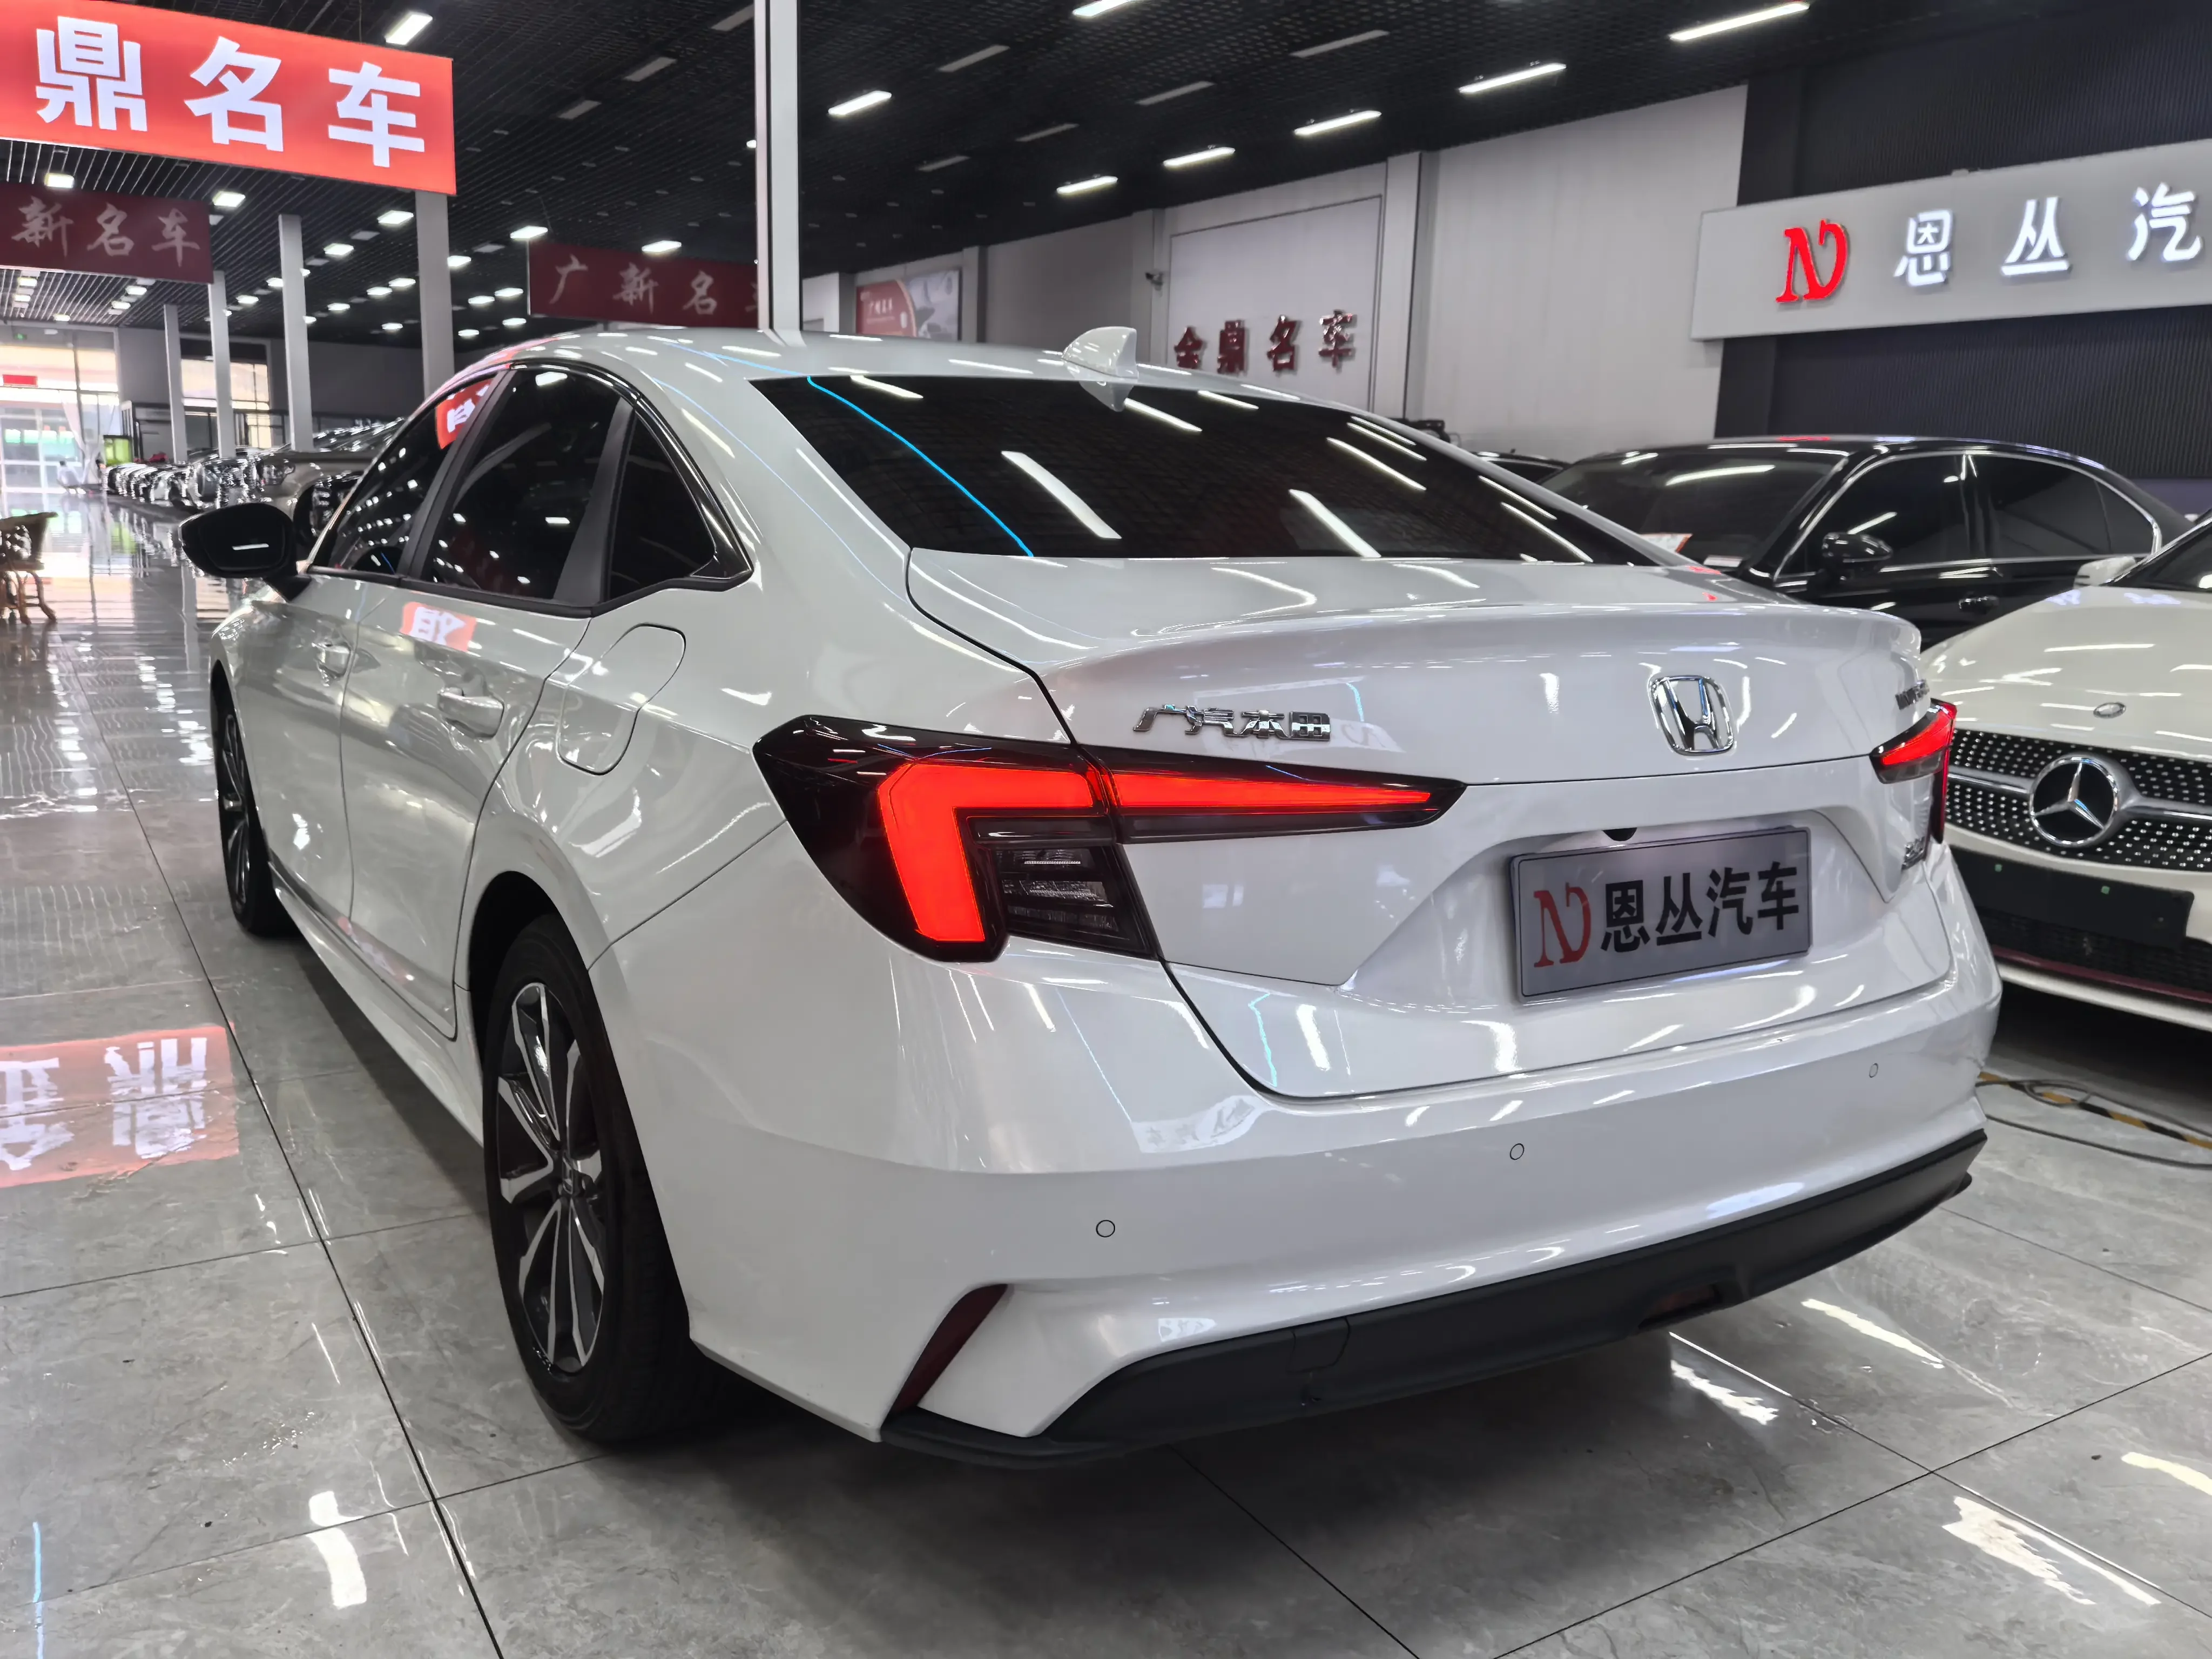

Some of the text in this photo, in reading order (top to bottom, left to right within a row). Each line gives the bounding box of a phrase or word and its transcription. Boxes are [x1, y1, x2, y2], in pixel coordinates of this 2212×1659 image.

[36, 16, 424, 167] 鼎名车
[11, 195, 200, 267] 新名车
[1894, 183, 2203, 287] 恩丛汽
[549, 254, 757, 315] 广新名
[1132, 703, 1331, 741] 广汽本田
[1600, 861, 1799, 953] 恩丛汽车
